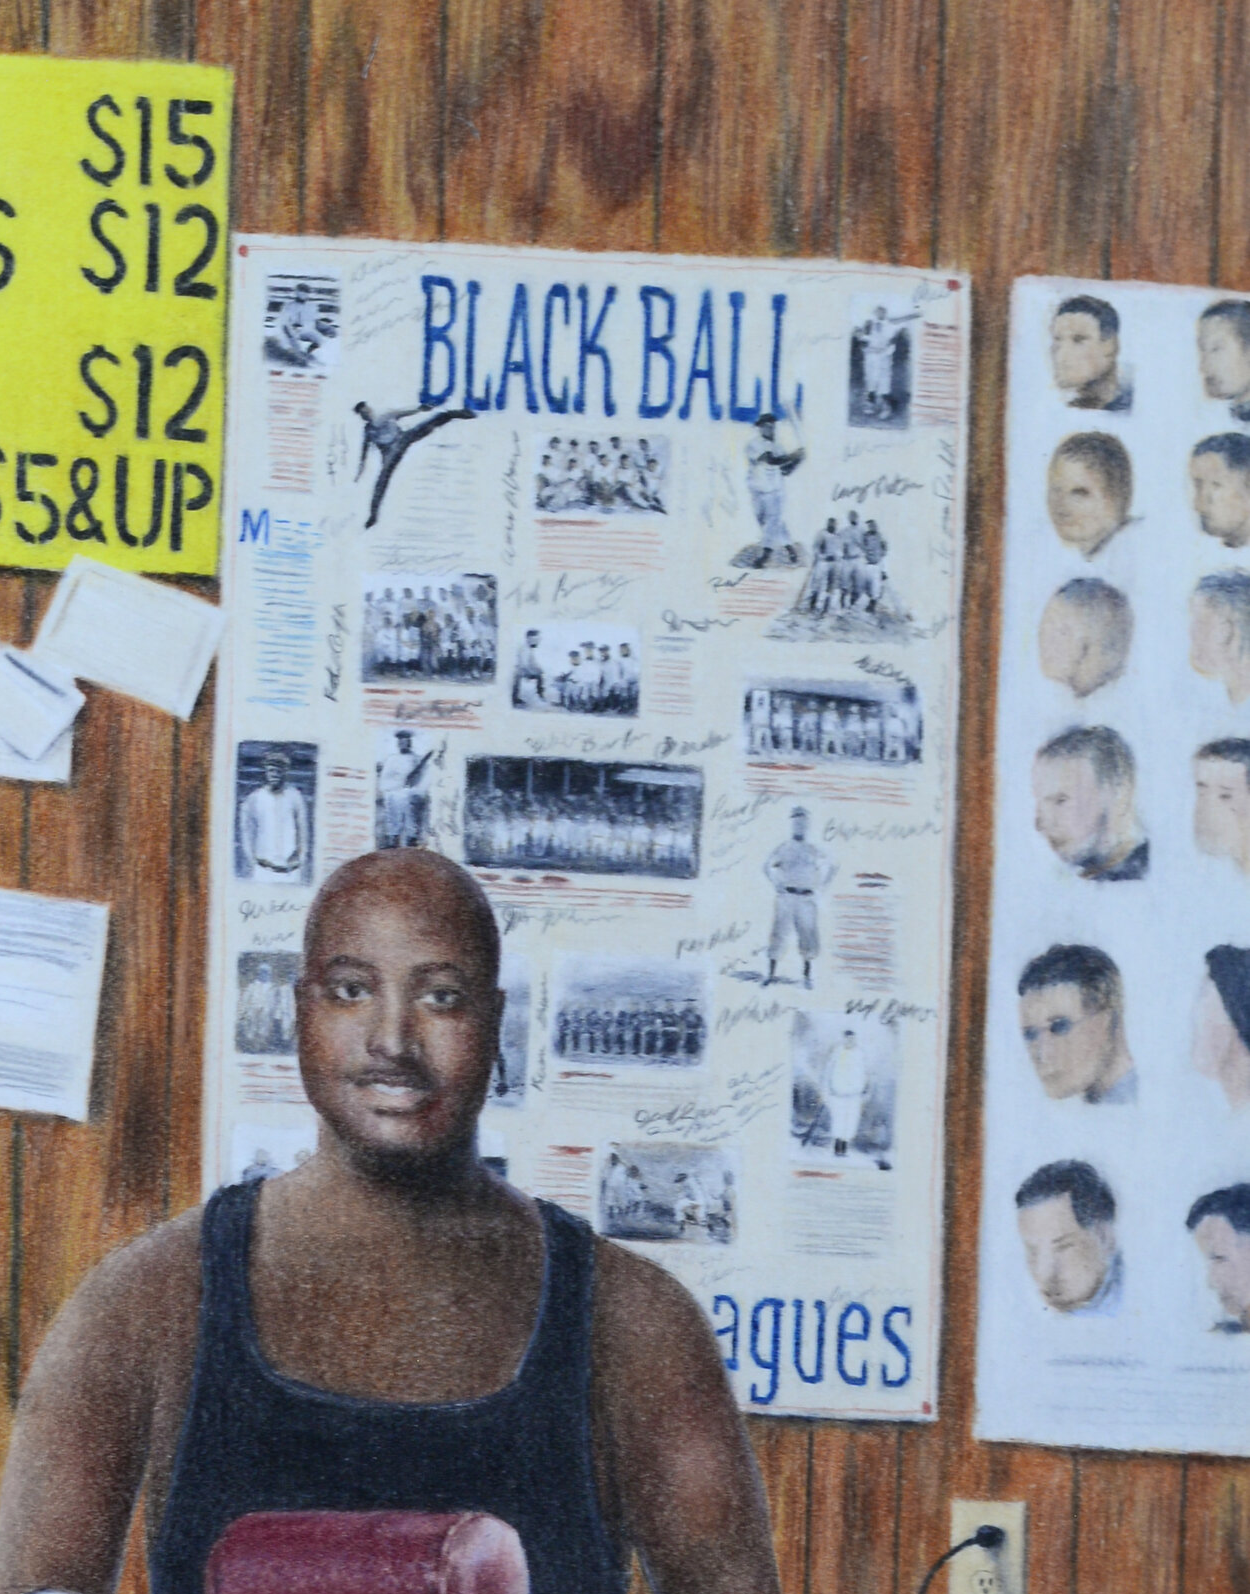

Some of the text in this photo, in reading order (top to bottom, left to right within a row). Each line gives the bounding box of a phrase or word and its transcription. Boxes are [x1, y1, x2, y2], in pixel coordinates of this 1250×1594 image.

[80, 94, 216, 188] $15
[81, 199, 219, 299] $12
[79, 344, 211, 443] $12
[419, 274, 618, 416] BLACK
[637, 284, 803, 421] BALL
